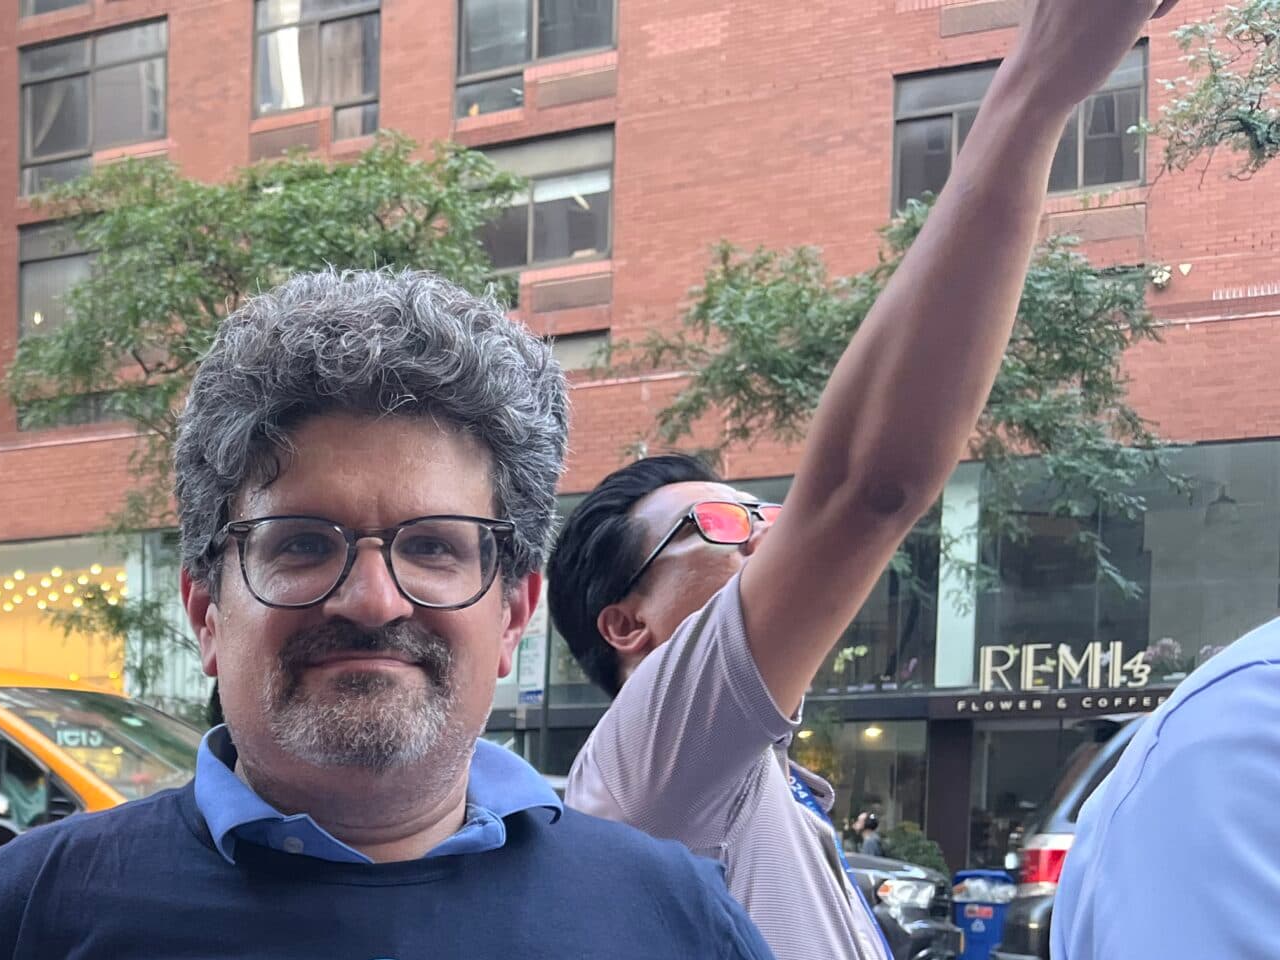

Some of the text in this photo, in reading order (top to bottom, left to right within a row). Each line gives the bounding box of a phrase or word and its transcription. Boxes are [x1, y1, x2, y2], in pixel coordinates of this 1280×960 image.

[979, 641, 1122, 692] REMI
[957, 699, 1042, 712] FLOWER
[1057, 697, 1067, 709] &
[788, 776, 809, 799] 024
